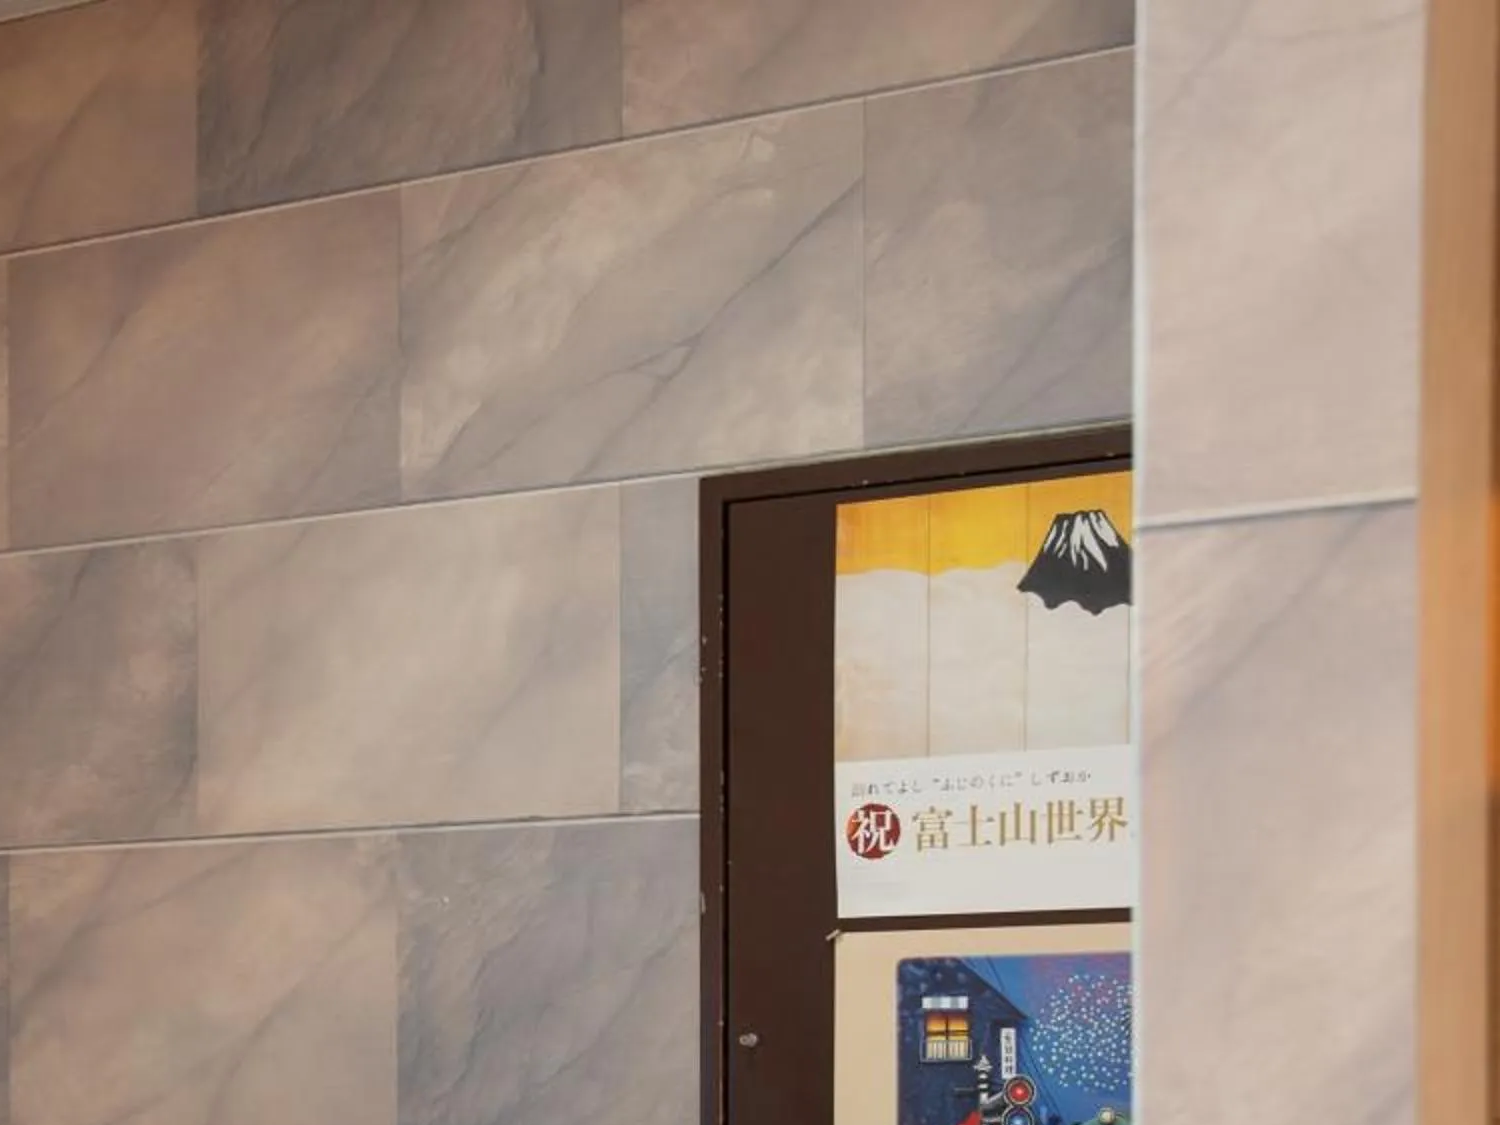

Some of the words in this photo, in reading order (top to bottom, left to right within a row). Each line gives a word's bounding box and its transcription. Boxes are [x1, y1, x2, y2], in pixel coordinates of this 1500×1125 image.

[851, 808, 896, 854] 祝
[911, 797, 1129, 852] 富士山世界
